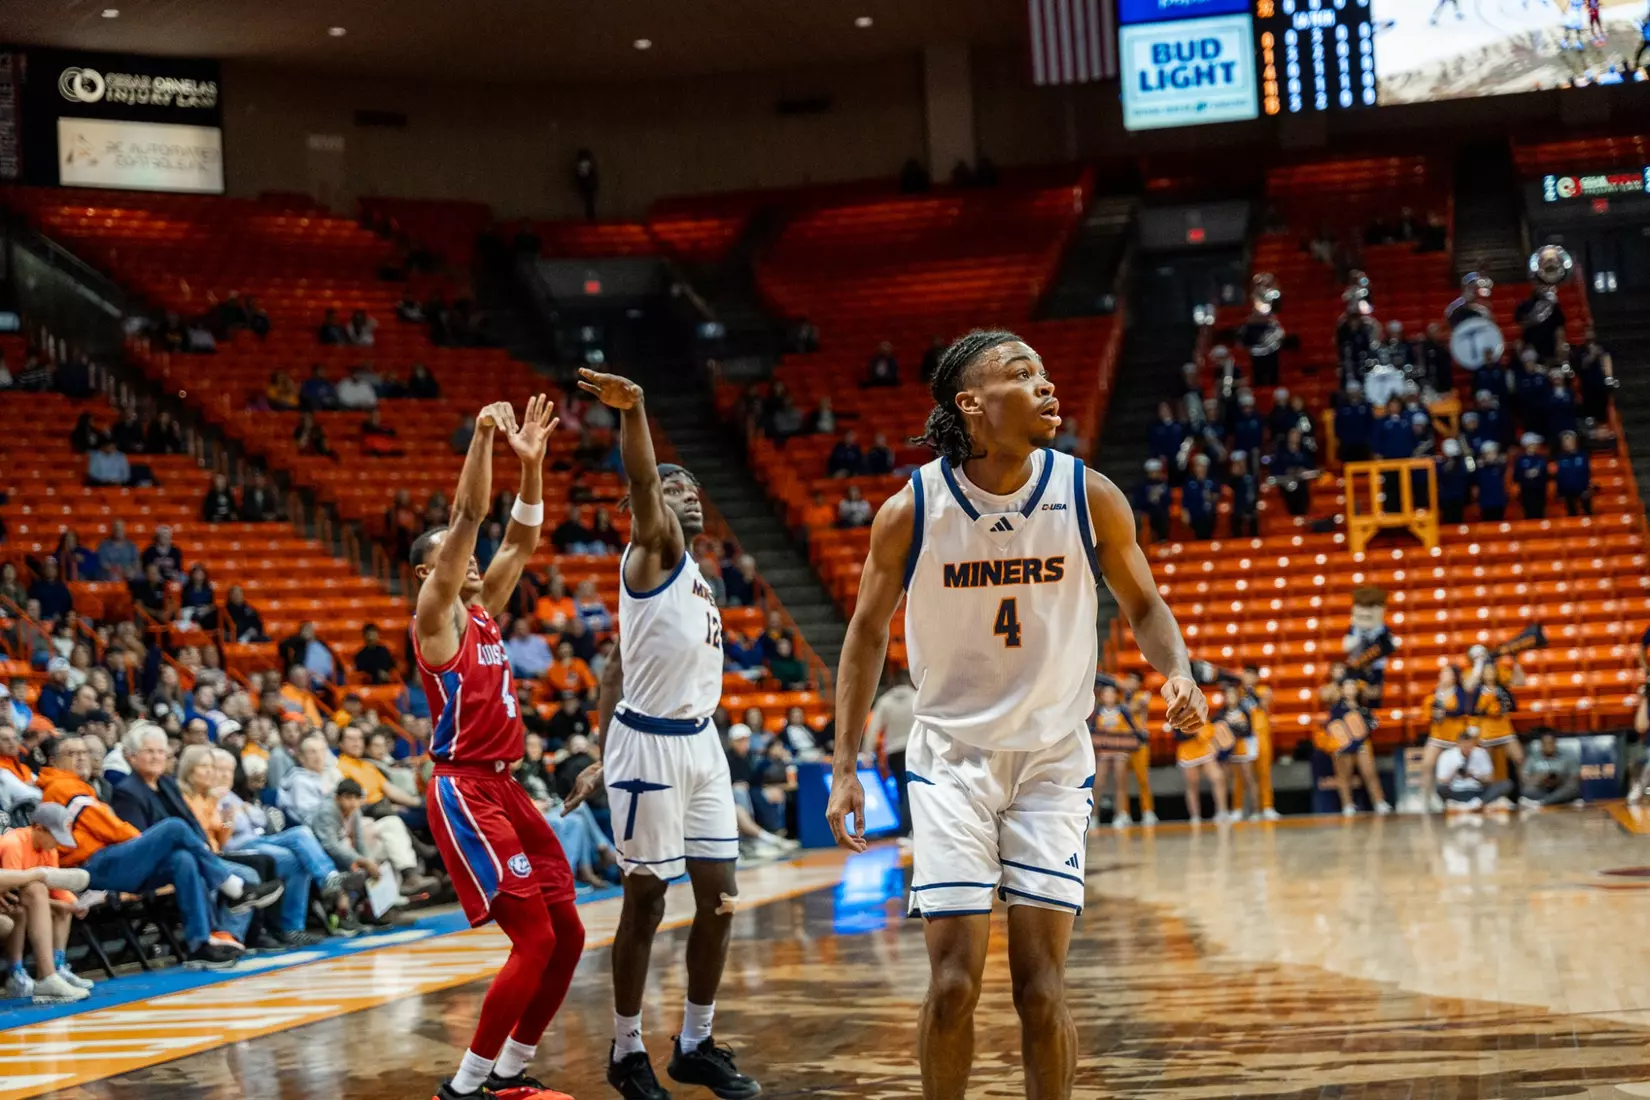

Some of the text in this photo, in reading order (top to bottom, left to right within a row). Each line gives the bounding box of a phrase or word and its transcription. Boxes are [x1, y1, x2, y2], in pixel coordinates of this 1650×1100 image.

[1152, 37, 1221, 65] BUD
[1139, 61, 1236, 92] LIGHT
[1041, 503, 1067, 511] C-USA
[943, 557, 1065, 587] MINERS
[705, 611, 720, 649] 12
[993, 597, 1022, 648] 4
